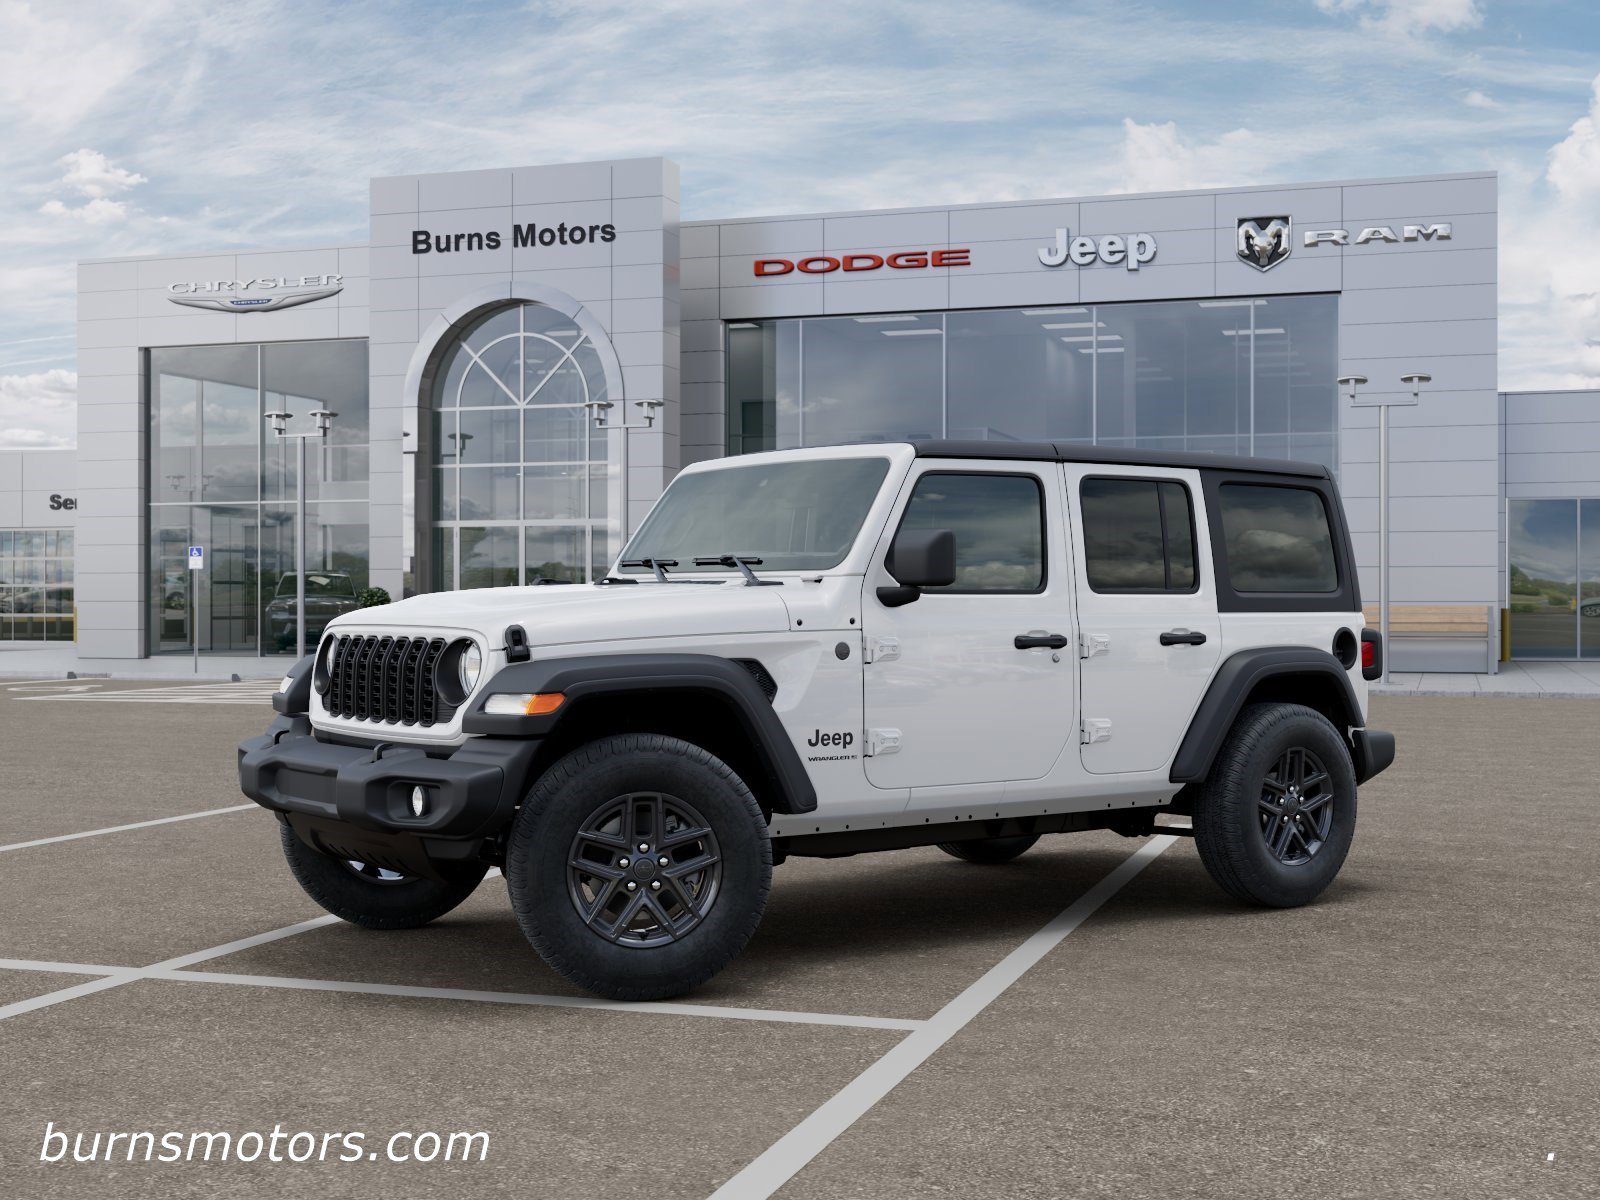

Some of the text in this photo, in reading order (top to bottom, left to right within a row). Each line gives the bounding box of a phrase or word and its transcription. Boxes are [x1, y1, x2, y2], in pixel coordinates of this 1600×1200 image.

[412, 222, 616, 254] Burns Motors
[1304, 223, 1452, 248] RAM
[754, 249, 971, 276] DODGE
[1038, 227, 1157, 272] Jeep
[167, 273, 343, 294] CHRYSLER
[807, 729, 854, 749] Jeep
